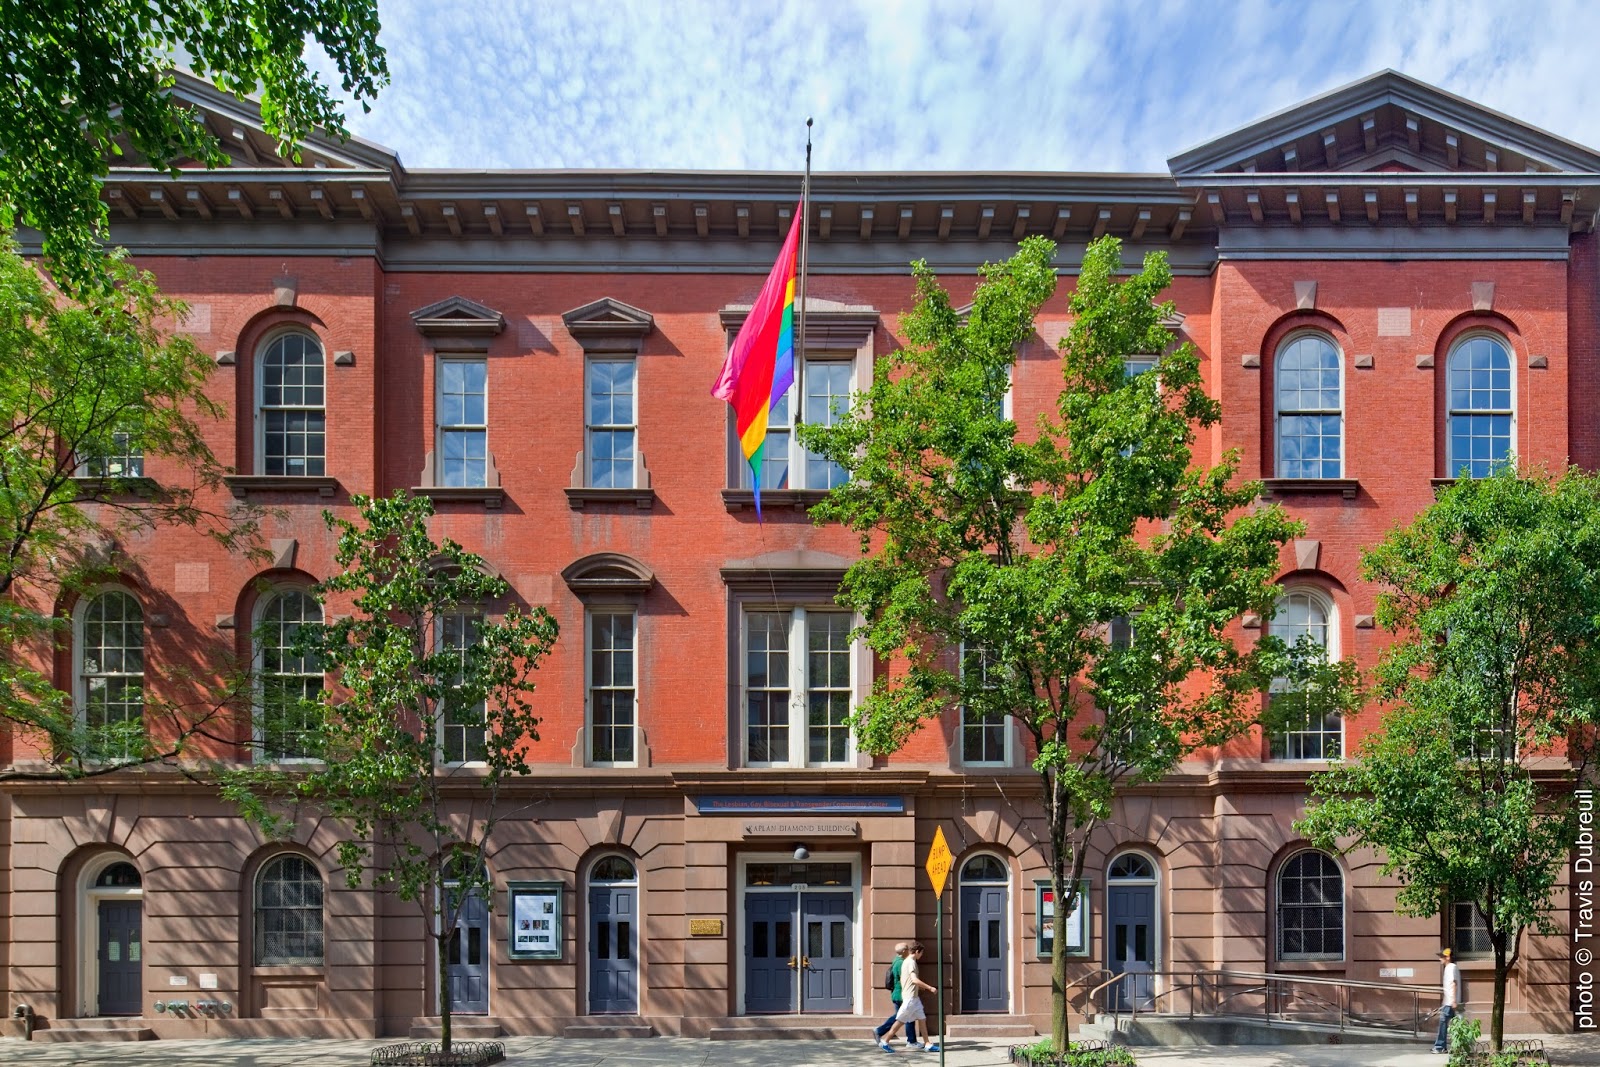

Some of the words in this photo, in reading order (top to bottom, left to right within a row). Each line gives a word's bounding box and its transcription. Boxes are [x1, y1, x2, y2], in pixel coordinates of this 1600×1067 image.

[796, 801, 832, 809] Transgender
[932, 844, 945, 860] BUMP
[932, 861, 946, 875] AHEAD
